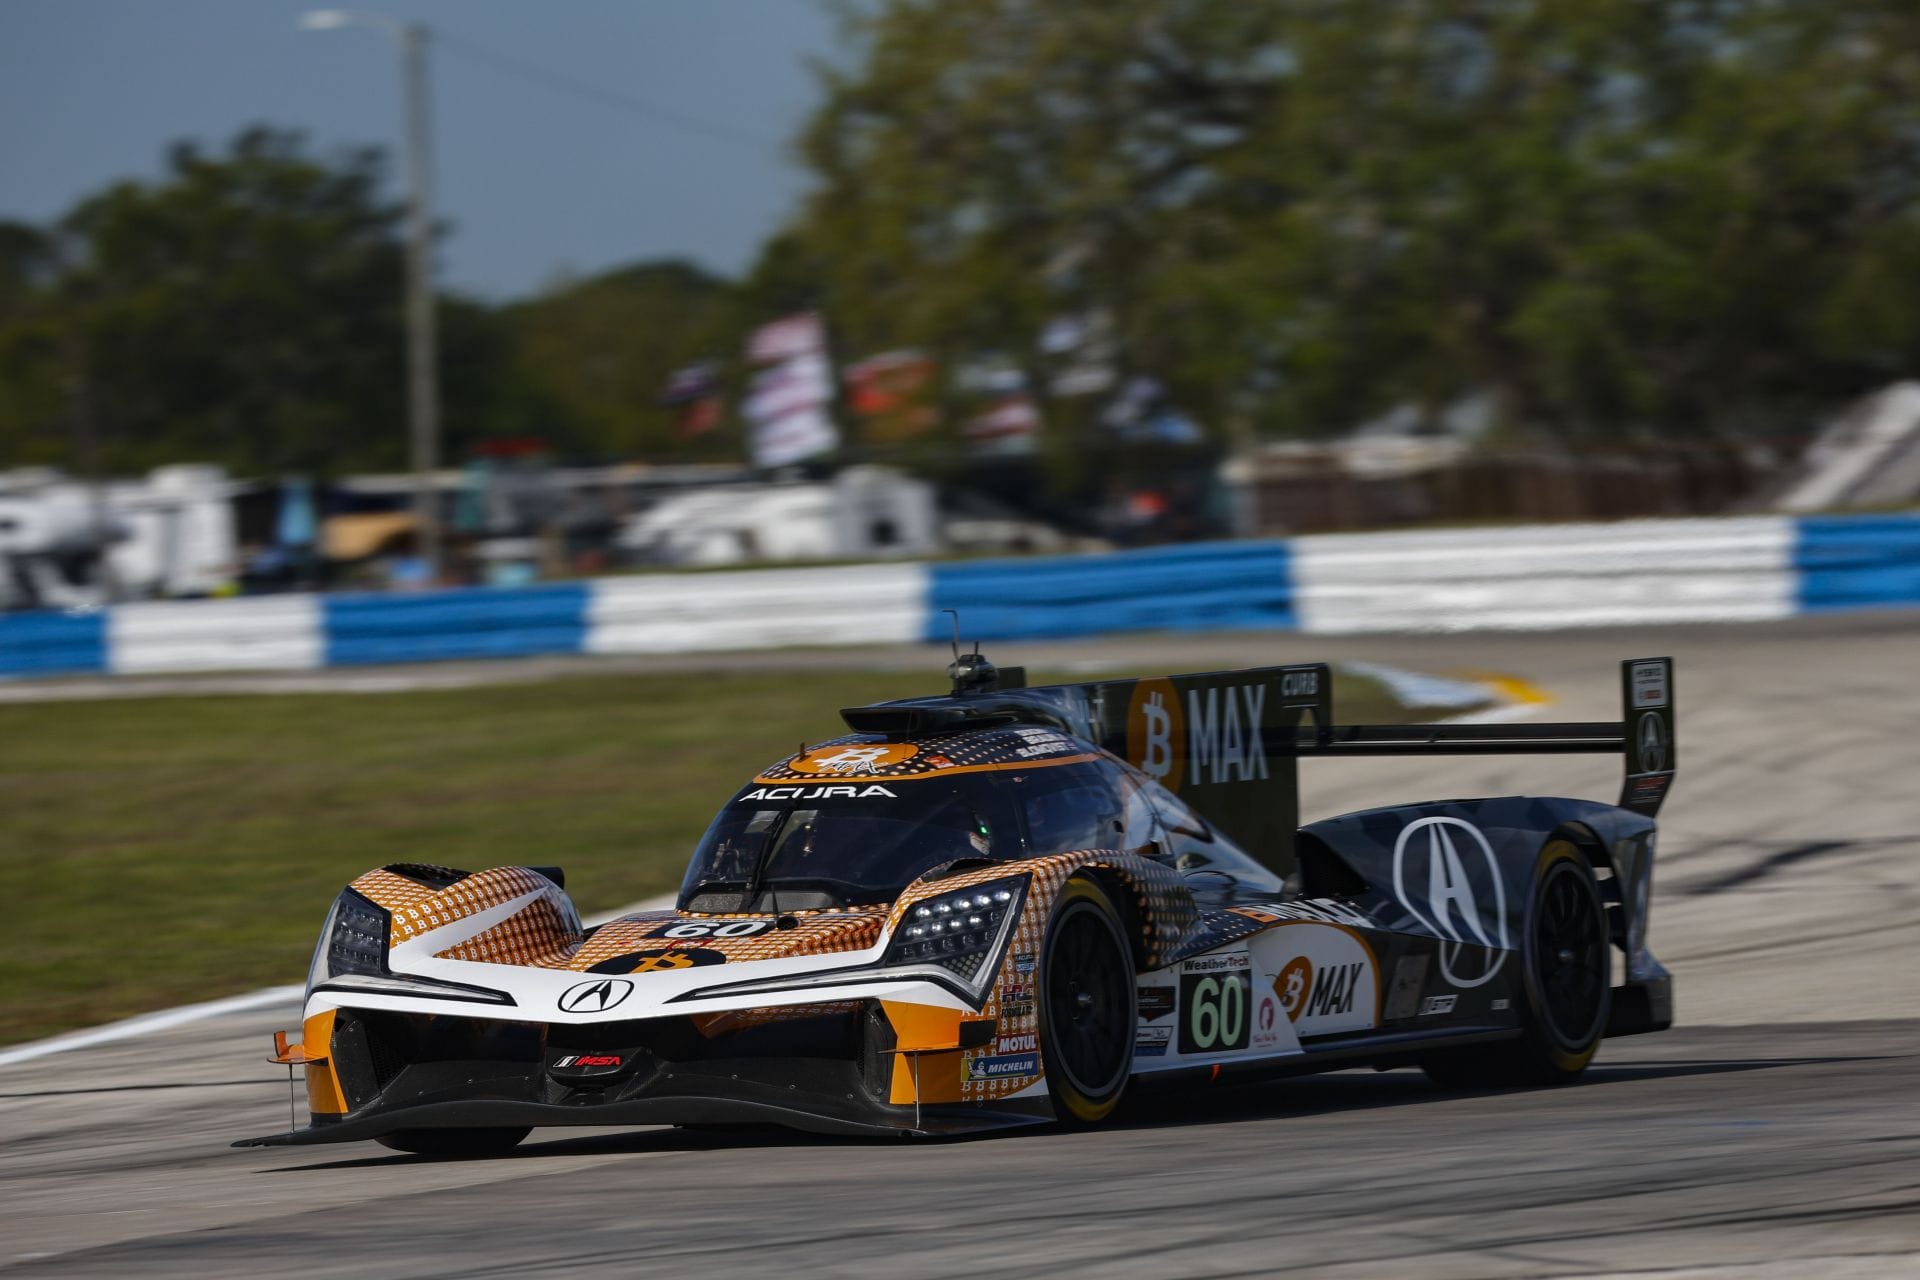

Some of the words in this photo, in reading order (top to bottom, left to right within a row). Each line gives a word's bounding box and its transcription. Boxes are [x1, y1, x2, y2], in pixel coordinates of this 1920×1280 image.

[1281, 673, 1318, 696] CURB
[1188, 684, 1268, 785] MAX
[738, 786, 898, 801] ACURA
[664, 922, 767, 938] 60
[1184, 957, 1249, 971] WeatherTech
[1307, 962, 1363, 1017] MAX
[1191, 975, 1243, 1049] 60
[999, 1036, 1036, 1052] MOTUL
[575, 1056, 621, 1066] IMSA
[988, 1062, 1033, 1073] MICHELIN
